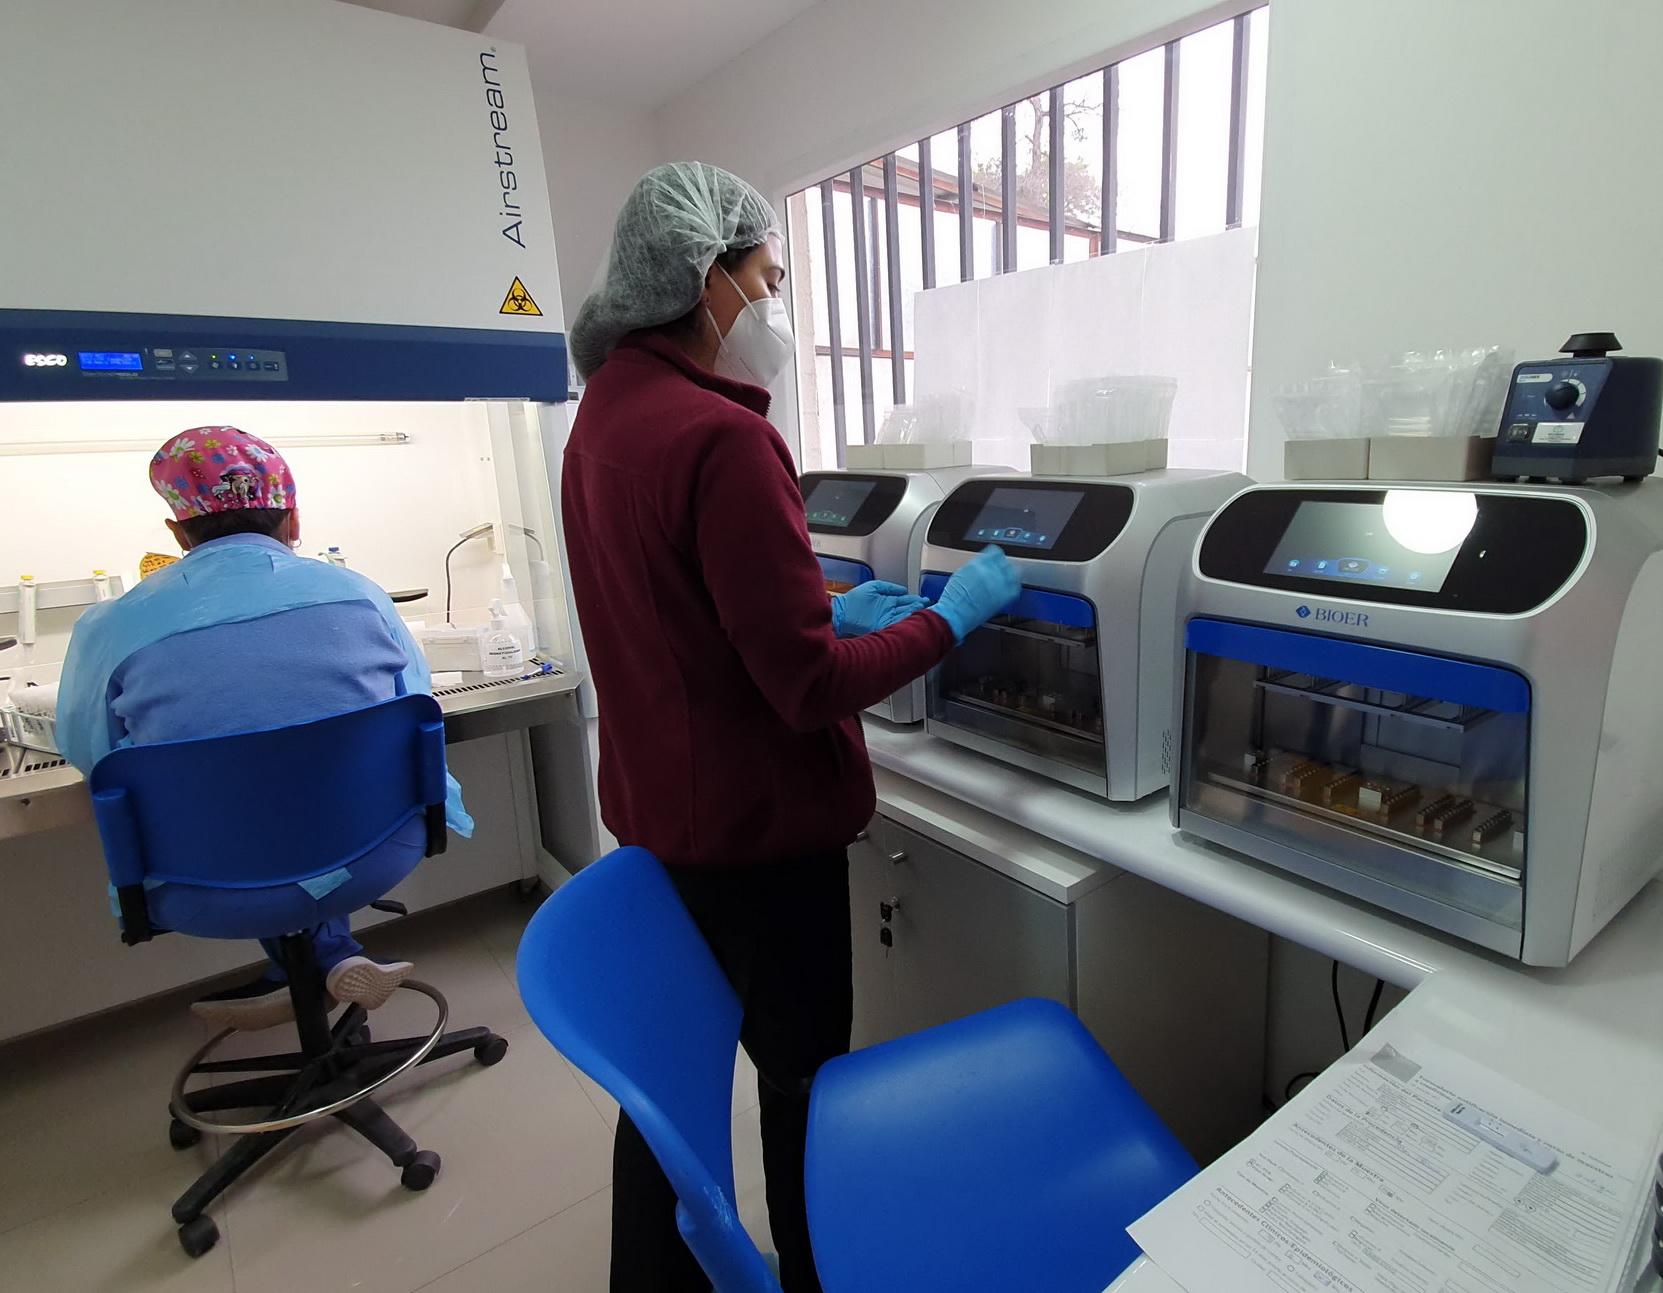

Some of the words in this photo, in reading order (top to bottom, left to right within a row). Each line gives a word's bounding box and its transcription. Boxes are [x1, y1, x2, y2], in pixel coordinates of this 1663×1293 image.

[479, 52, 526, 249] Airstream
[1315, 607, 1370, 628] BIOER
[1325, 1093, 1345, 1110] Datos
[1292, 1121, 1337, 1153] Antecedentes
[1353, 1160, 1385, 1183] Muestra
[1215, 1185, 1261, 1223] Antecedentes
[1260, 1218, 1290, 1245] Clínicos
[1289, 1241, 1355, 1293] Epidemiológicos
